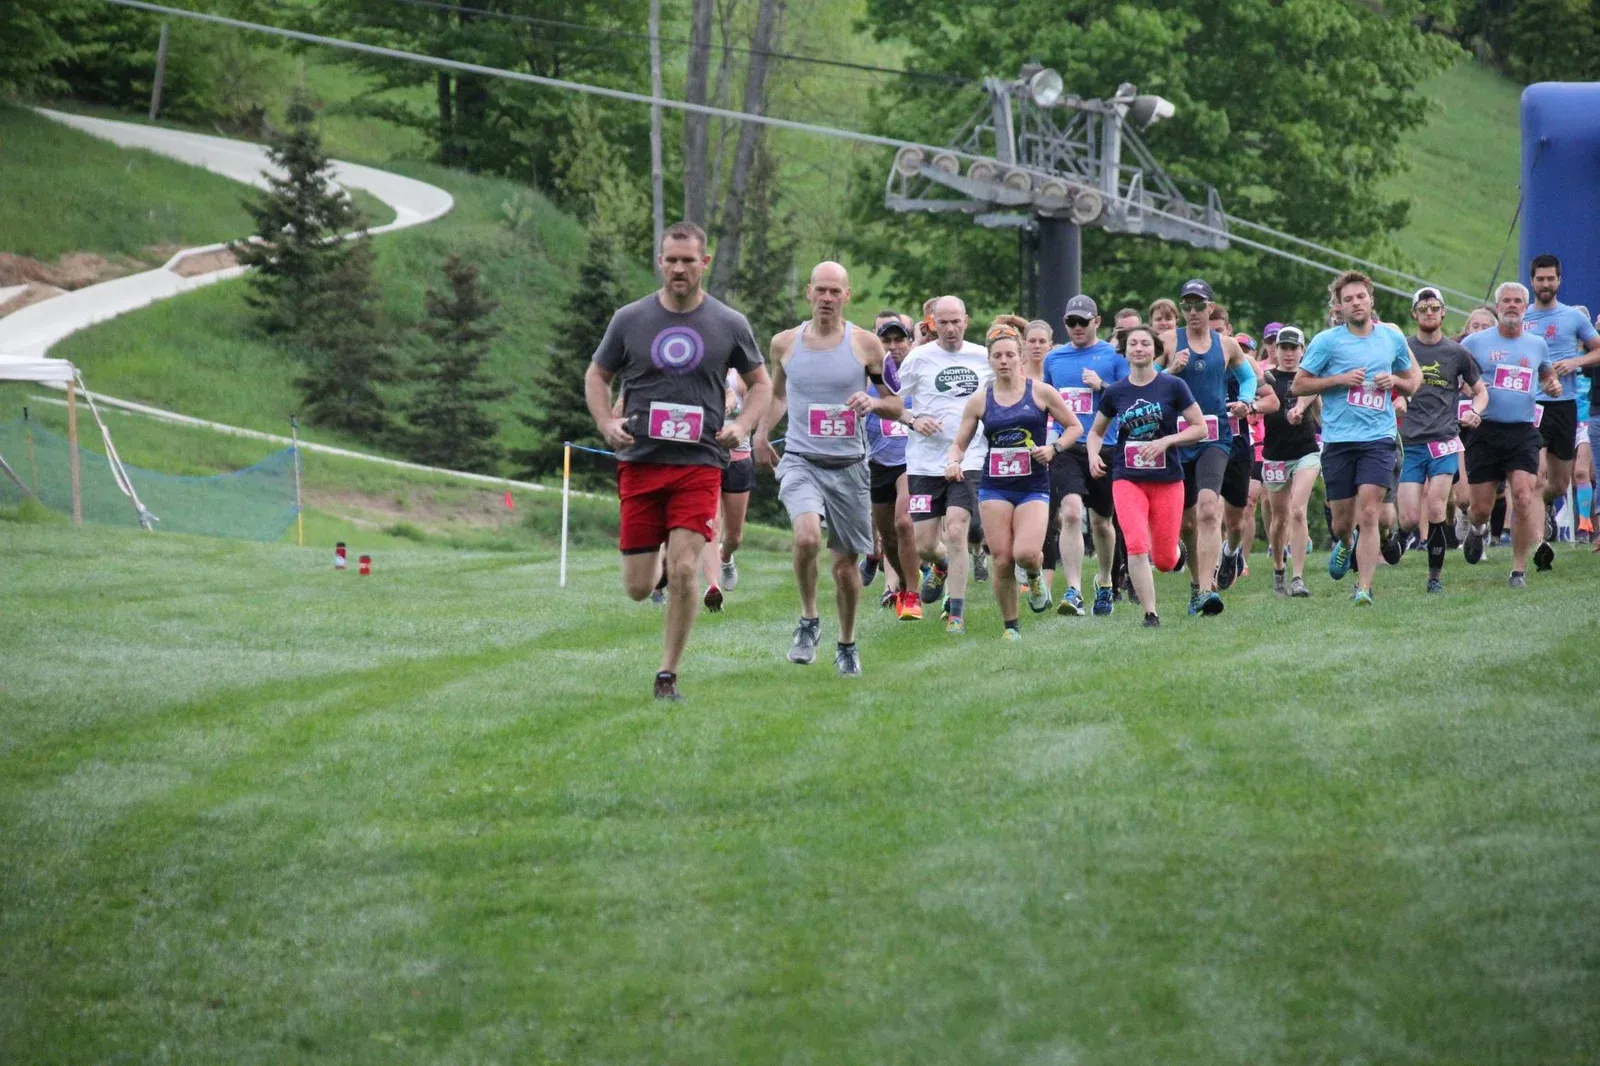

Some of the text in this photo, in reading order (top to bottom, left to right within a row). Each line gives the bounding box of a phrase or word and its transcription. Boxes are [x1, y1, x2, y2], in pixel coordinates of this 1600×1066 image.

[938, 374, 976, 382] COUNTRY
[1502, 376, 1523, 390] 86
[1352, 391, 1383, 408] 100
[660, 420, 691, 440] 82
[820, 419, 847, 436] 55
[1437, 440, 1458, 455] 99
[997, 460, 1022, 475] 54
[1265, 469, 1285, 481] 98
[909, 497, 927, 511] 64
